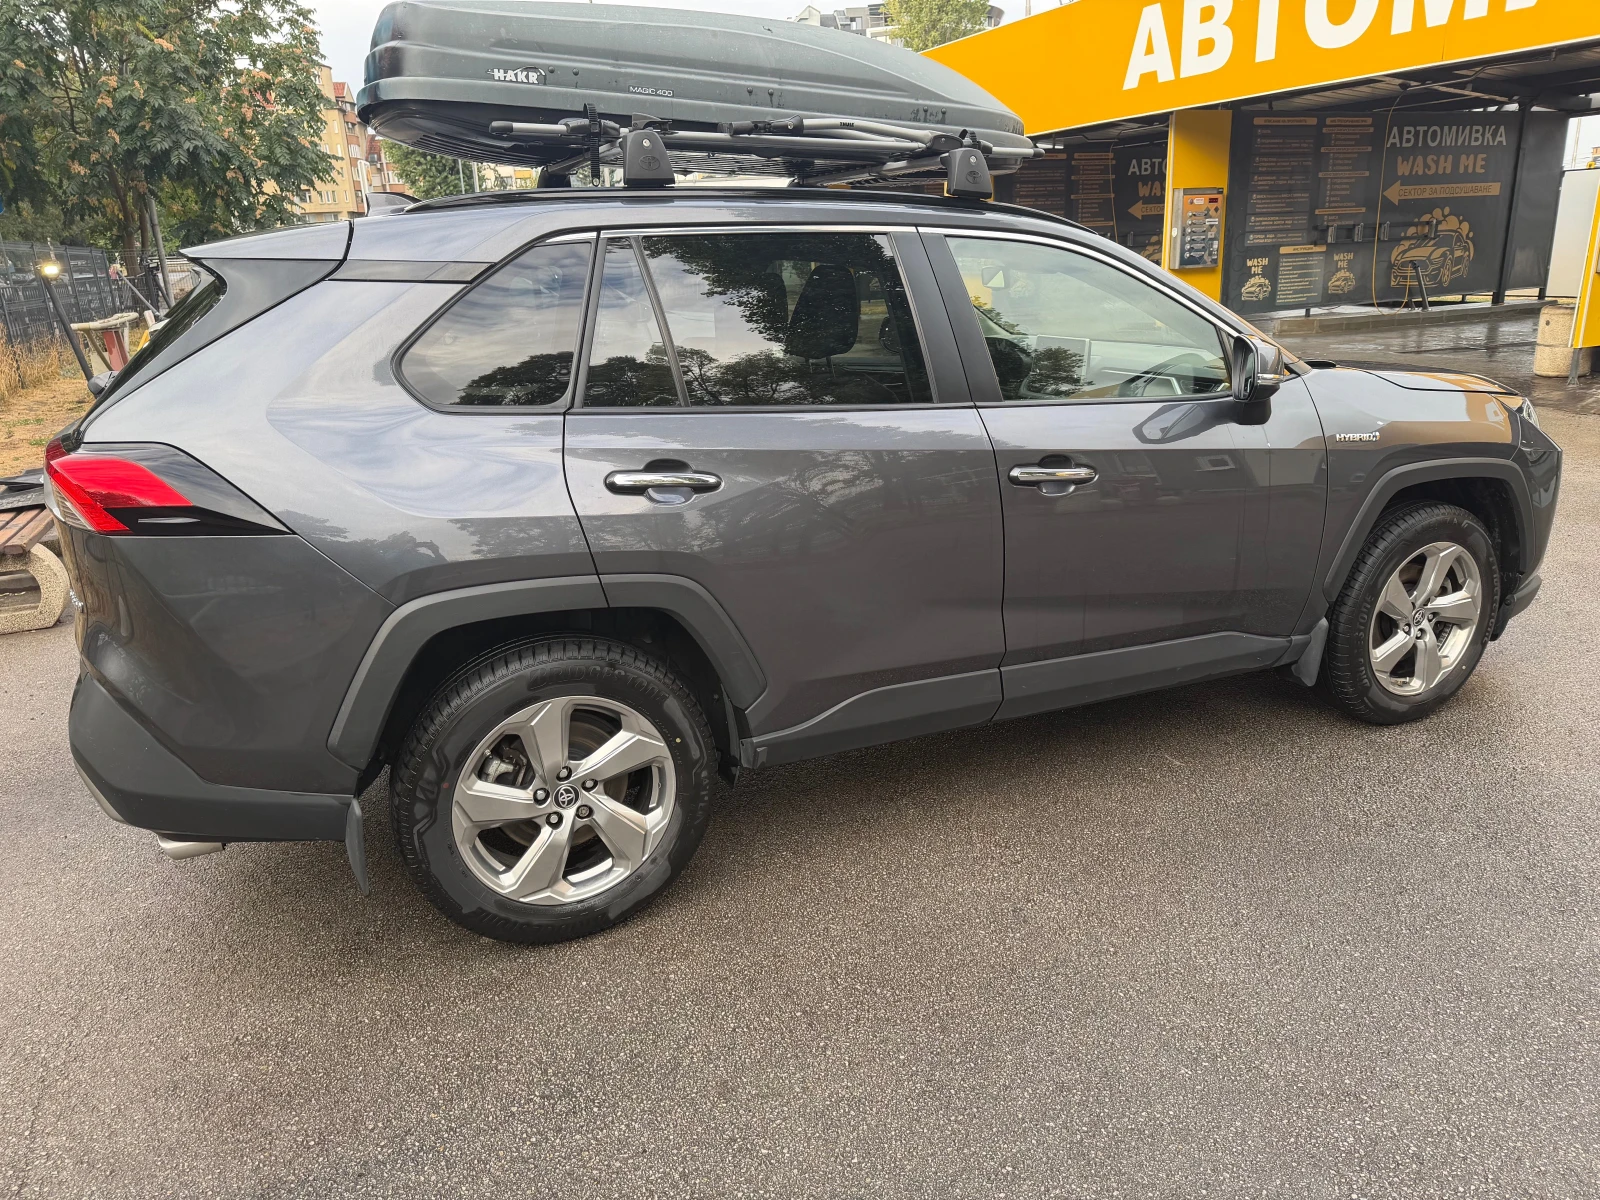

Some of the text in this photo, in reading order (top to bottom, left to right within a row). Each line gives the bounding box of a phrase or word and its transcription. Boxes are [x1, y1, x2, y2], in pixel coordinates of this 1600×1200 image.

[493, 68, 539, 84] HAKR
[629, 86, 655, 95] MAGIC
[1386, 125, 1507, 148] АВТОМИВКА
[1397, 153, 1487, 176] WASH ME
[1138, 180, 1166, 197] WA
[1398, 184, 1493, 197] СЕКТОР ЗА ПОДСУШАВАНЕ
[1247, 258, 1269, 266] WASH
[1334, 253, 1354, 261] WASH
[1337, 260, 1349, 268] ME
[1252, 266, 1263, 274] ME
[1335, 432, 1373, 442] HYBRID
